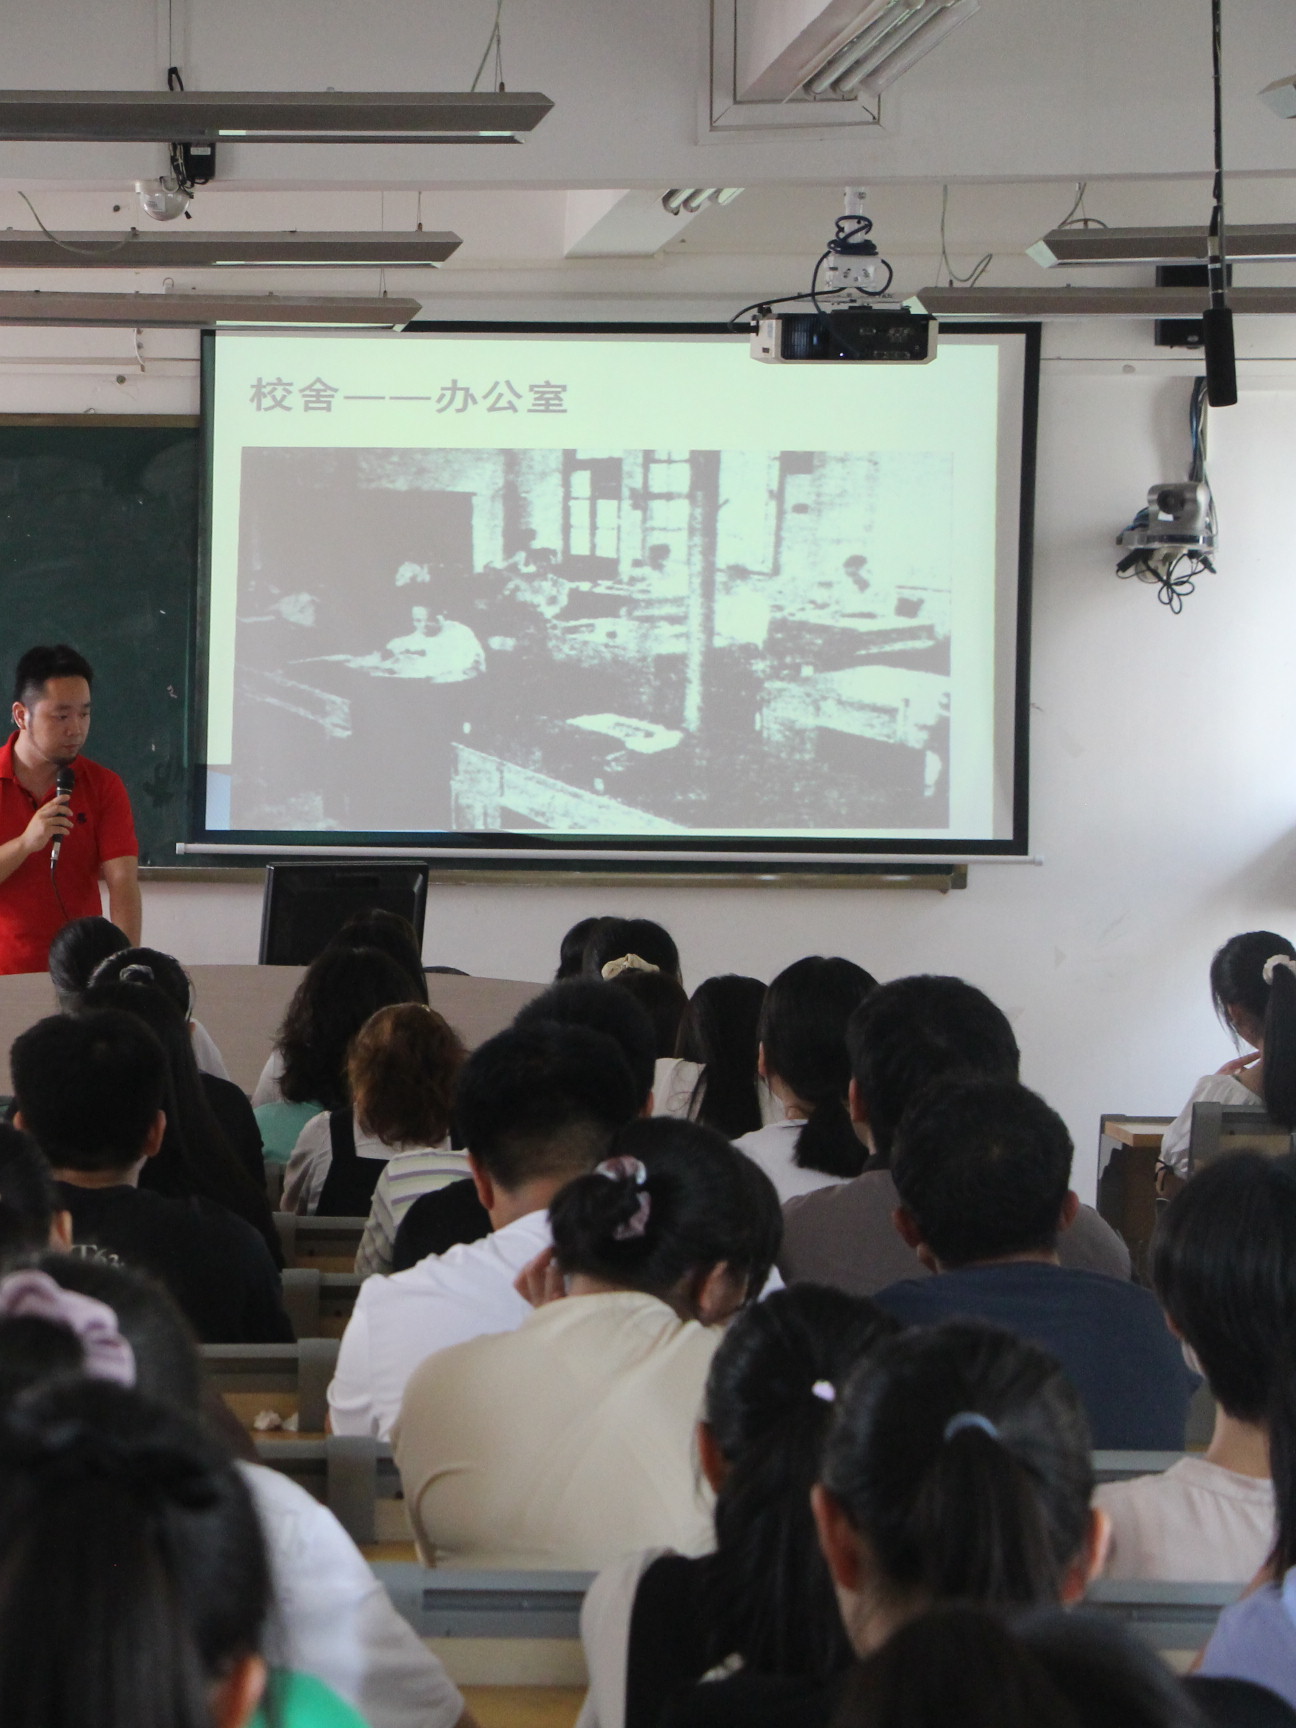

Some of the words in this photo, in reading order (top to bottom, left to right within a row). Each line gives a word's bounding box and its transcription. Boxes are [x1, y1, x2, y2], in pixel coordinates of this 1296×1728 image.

[249, 377, 568, 414] 校舍——办公室
